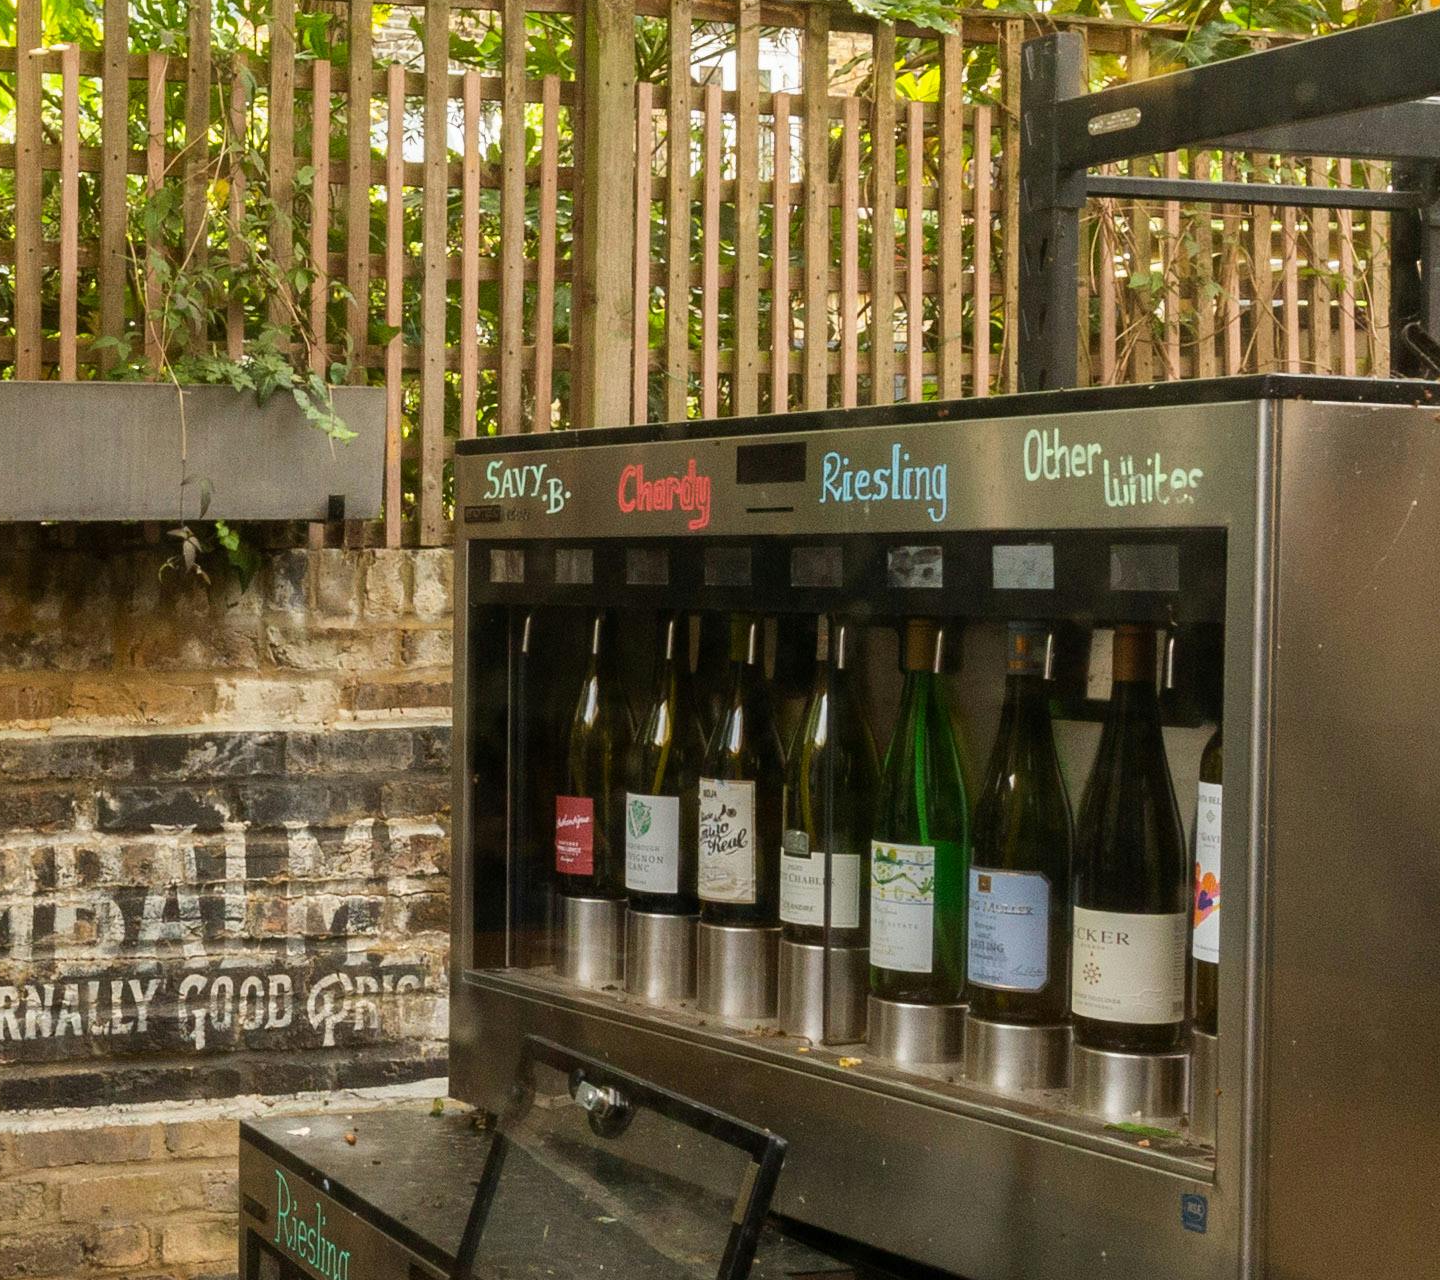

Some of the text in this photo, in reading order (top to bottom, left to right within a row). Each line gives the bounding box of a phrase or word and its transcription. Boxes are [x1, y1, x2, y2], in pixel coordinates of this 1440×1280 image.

[617, 457, 712, 531] Chardy
[819, 442, 948, 522] Riesling
[1023, 427, 1204, 507] Other Whites
[705, 828, 748, 856] Real
[176, 974, 292, 1050] GOOD
[307, 972, 449, 1047] PRIC
